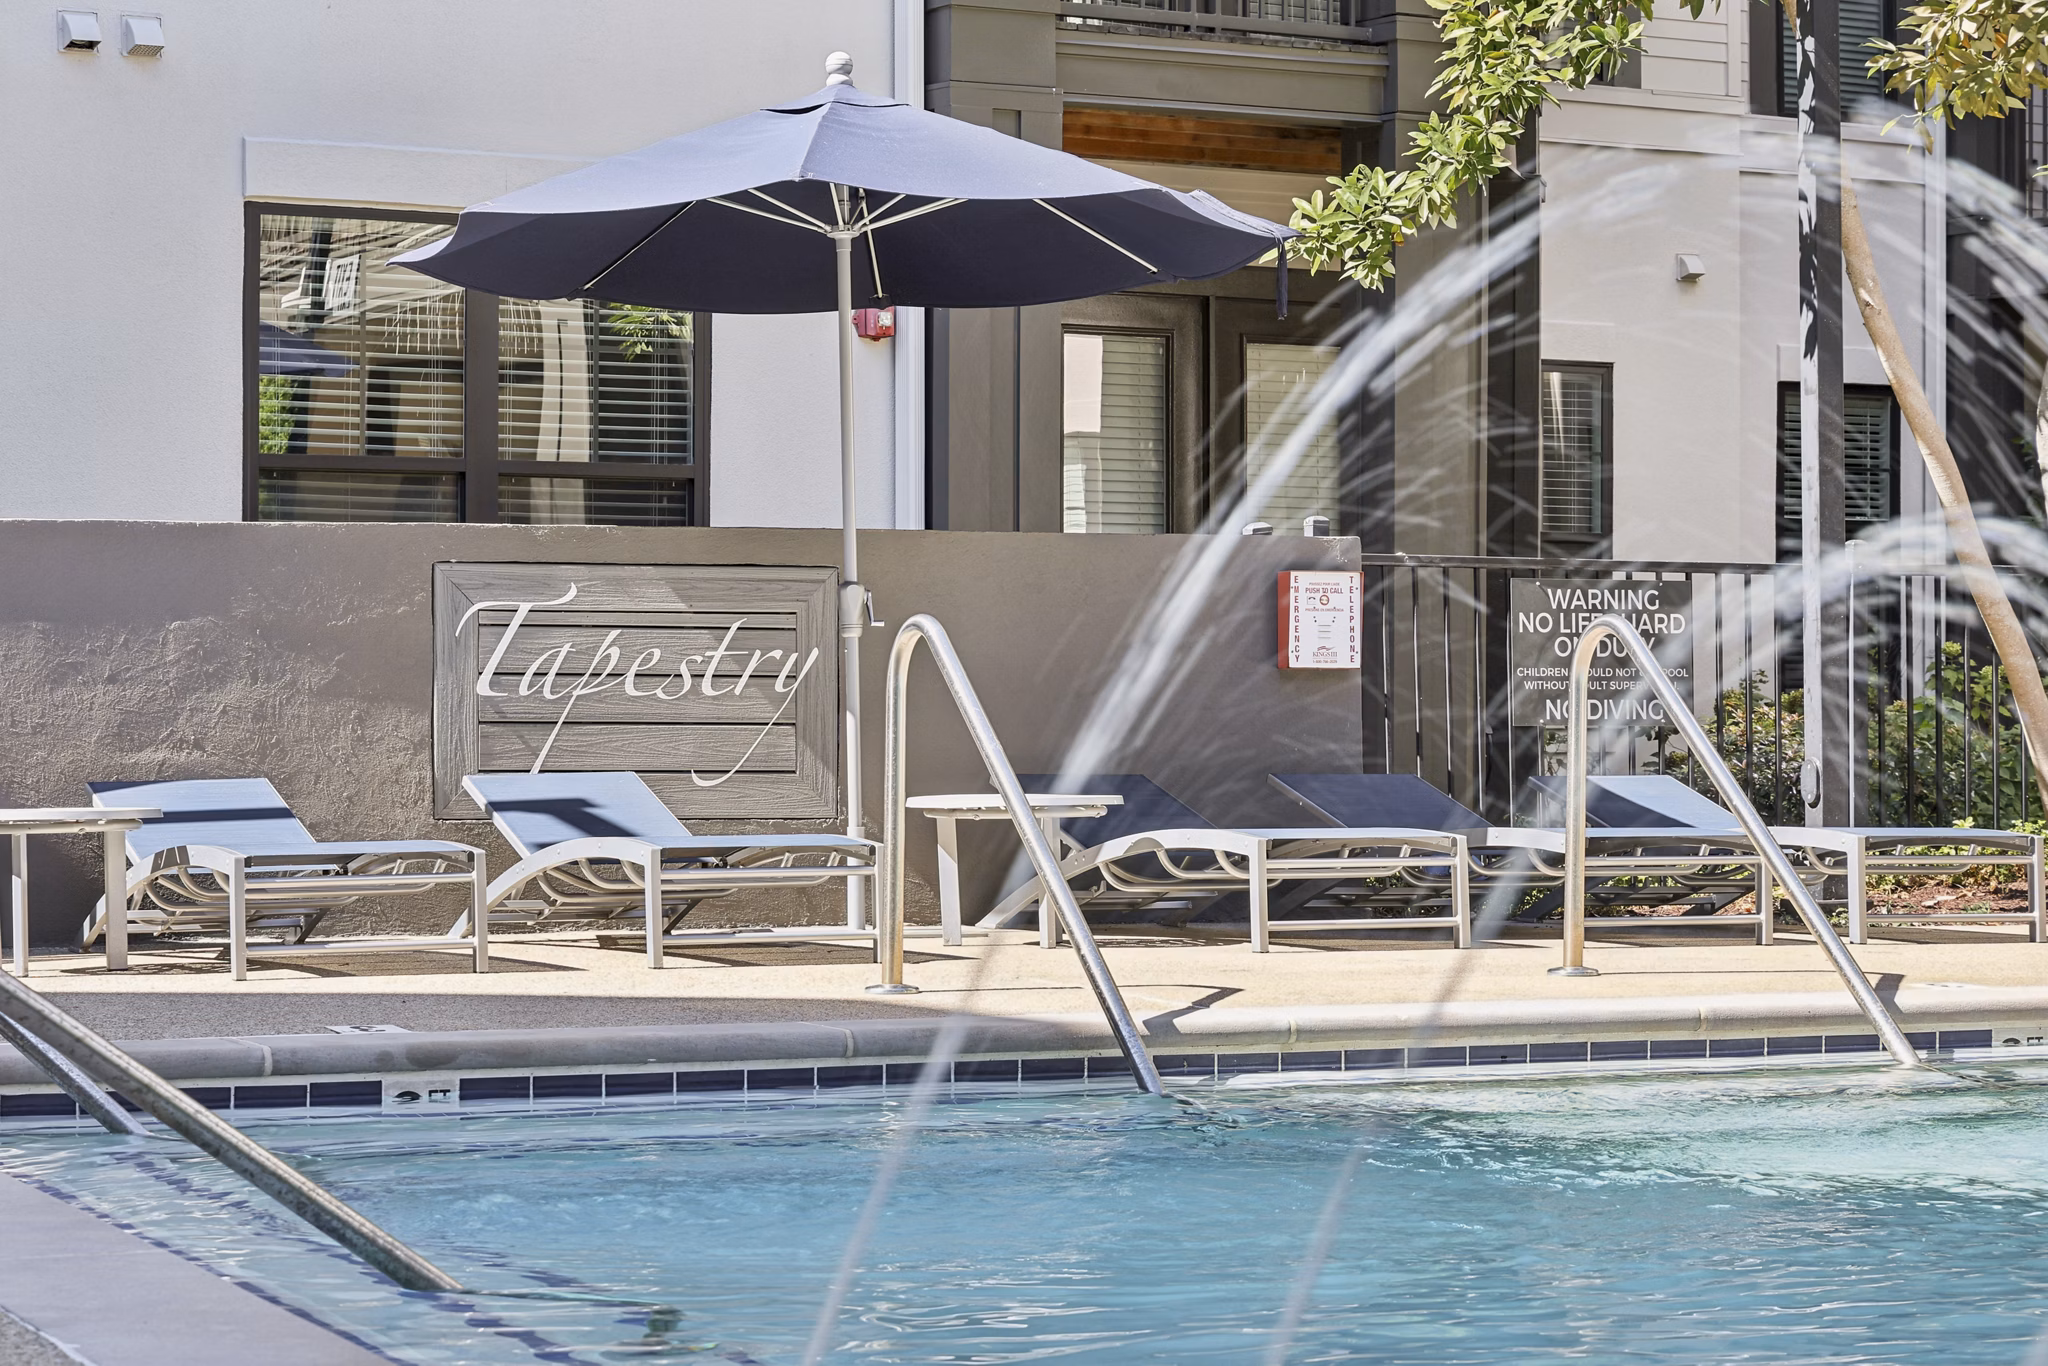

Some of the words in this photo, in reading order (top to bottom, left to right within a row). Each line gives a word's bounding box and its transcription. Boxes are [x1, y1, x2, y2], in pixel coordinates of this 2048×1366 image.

[1547, 588, 1660, 610] WARNING
[1518, 612, 1553, 633] NO
[1559, 612, 1686, 634] LIFARD
[1554, 636, 1579, 657] O
[1596, 637, 1655, 658] DU
[1516, 667, 1569, 677] CHILDREN
[1587, 667, 1613, 677] OULD
[1615, 667, 1637, 677] NOT
[455, 582, 819, 787] Tapestry
[1609, 681, 1680, 690] SUPERV.
[1546, 699, 1569, 720] N
[1587, 699, 1664, 720] DIVING
